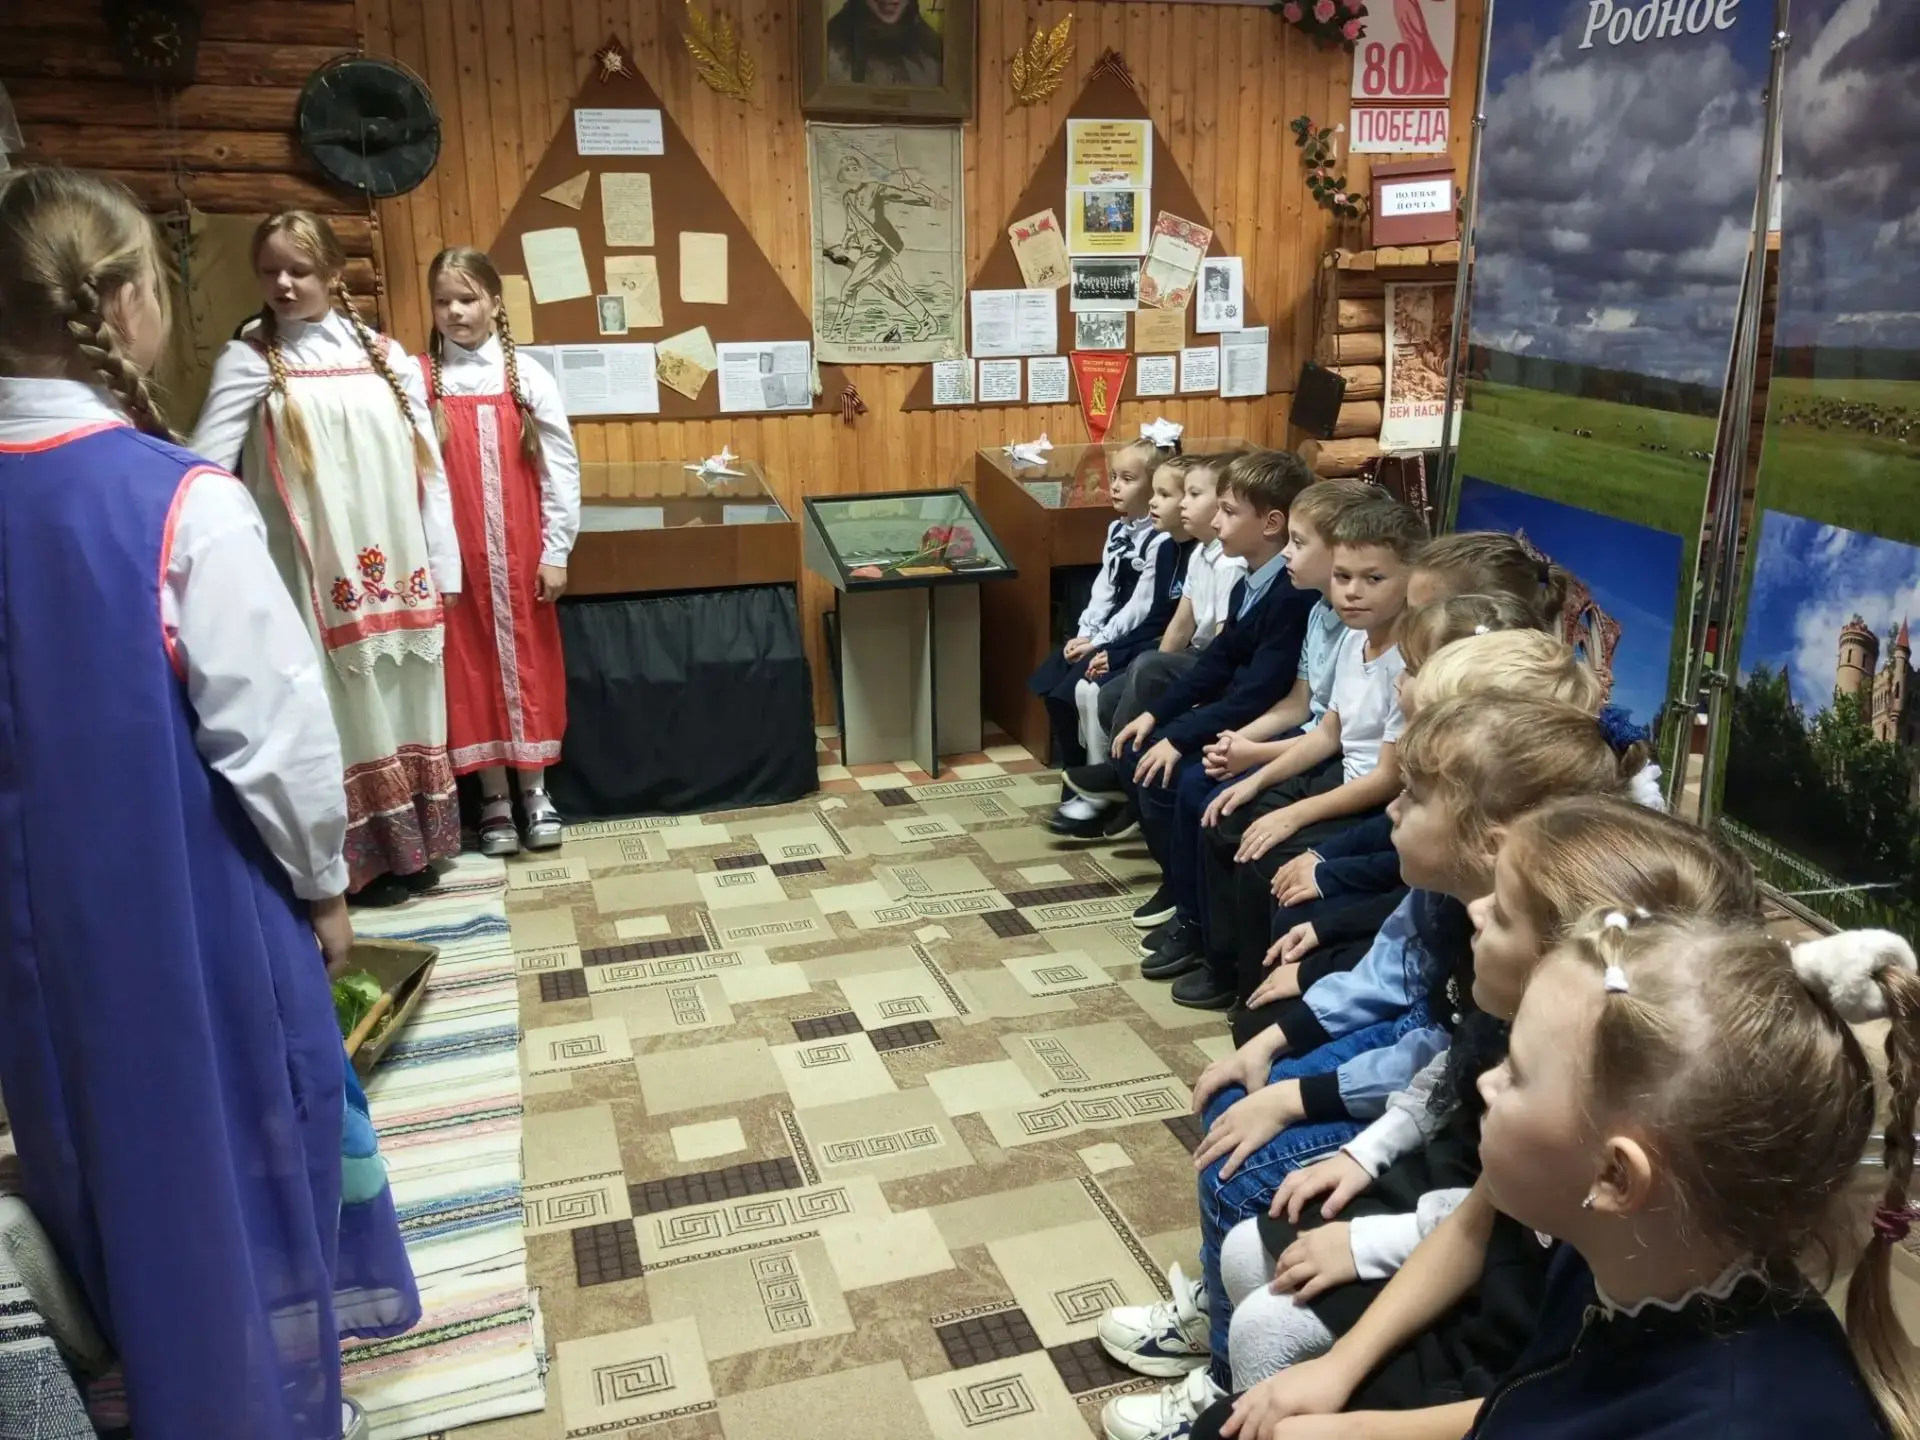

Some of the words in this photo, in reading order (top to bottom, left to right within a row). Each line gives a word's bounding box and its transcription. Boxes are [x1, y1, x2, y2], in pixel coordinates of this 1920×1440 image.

[1578, 0, 1742, 49] Родное
[1362, 42, 1412, 96] 80
[1358, 111, 1447, 146] ПОБЕДА
[1397, 201, 1436, 211] ПОЧТА
[1389, 403, 1410, 419] БЕЙ
